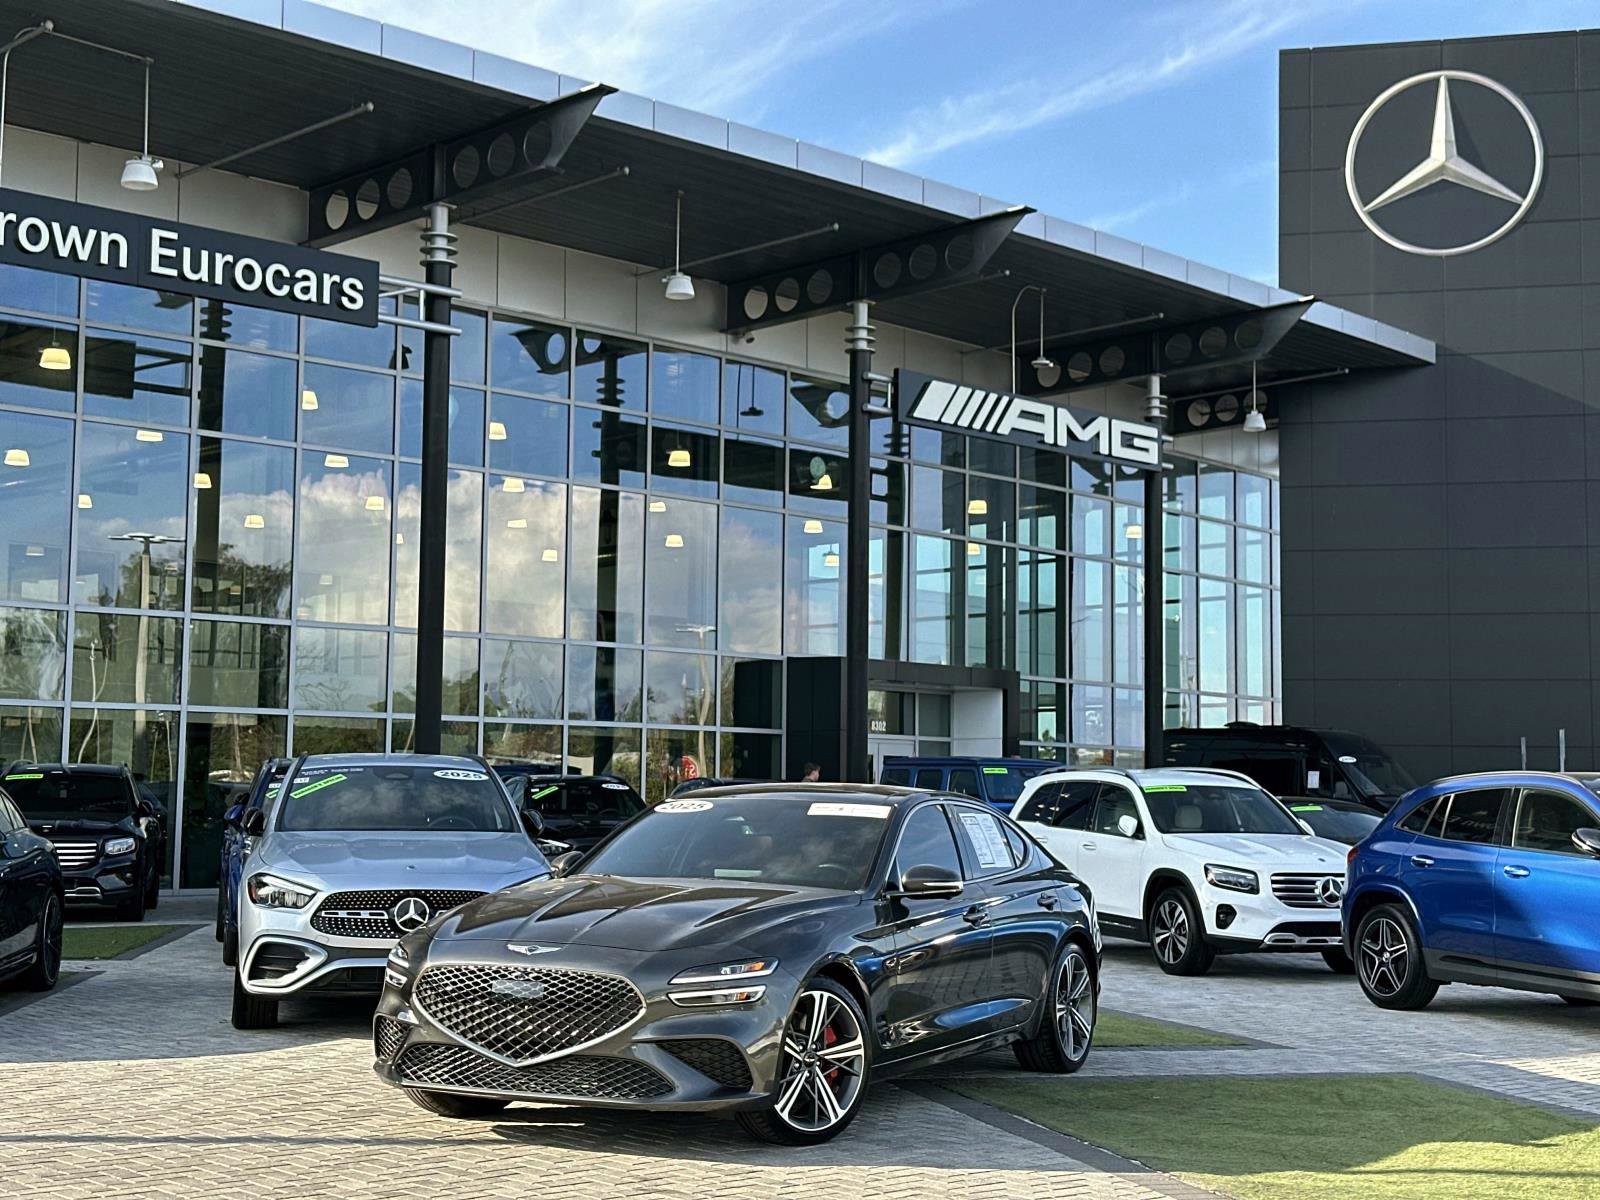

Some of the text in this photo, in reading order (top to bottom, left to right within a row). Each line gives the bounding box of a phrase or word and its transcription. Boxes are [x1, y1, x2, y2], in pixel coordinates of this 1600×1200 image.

[150, 227, 365, 311] Eurocars
[996, 397, 1159, 465] AMG
[871, 720, 887, 732] 8302
[439, 771, 483, 779] 2025
[659, 802, 708, 810] 2025
